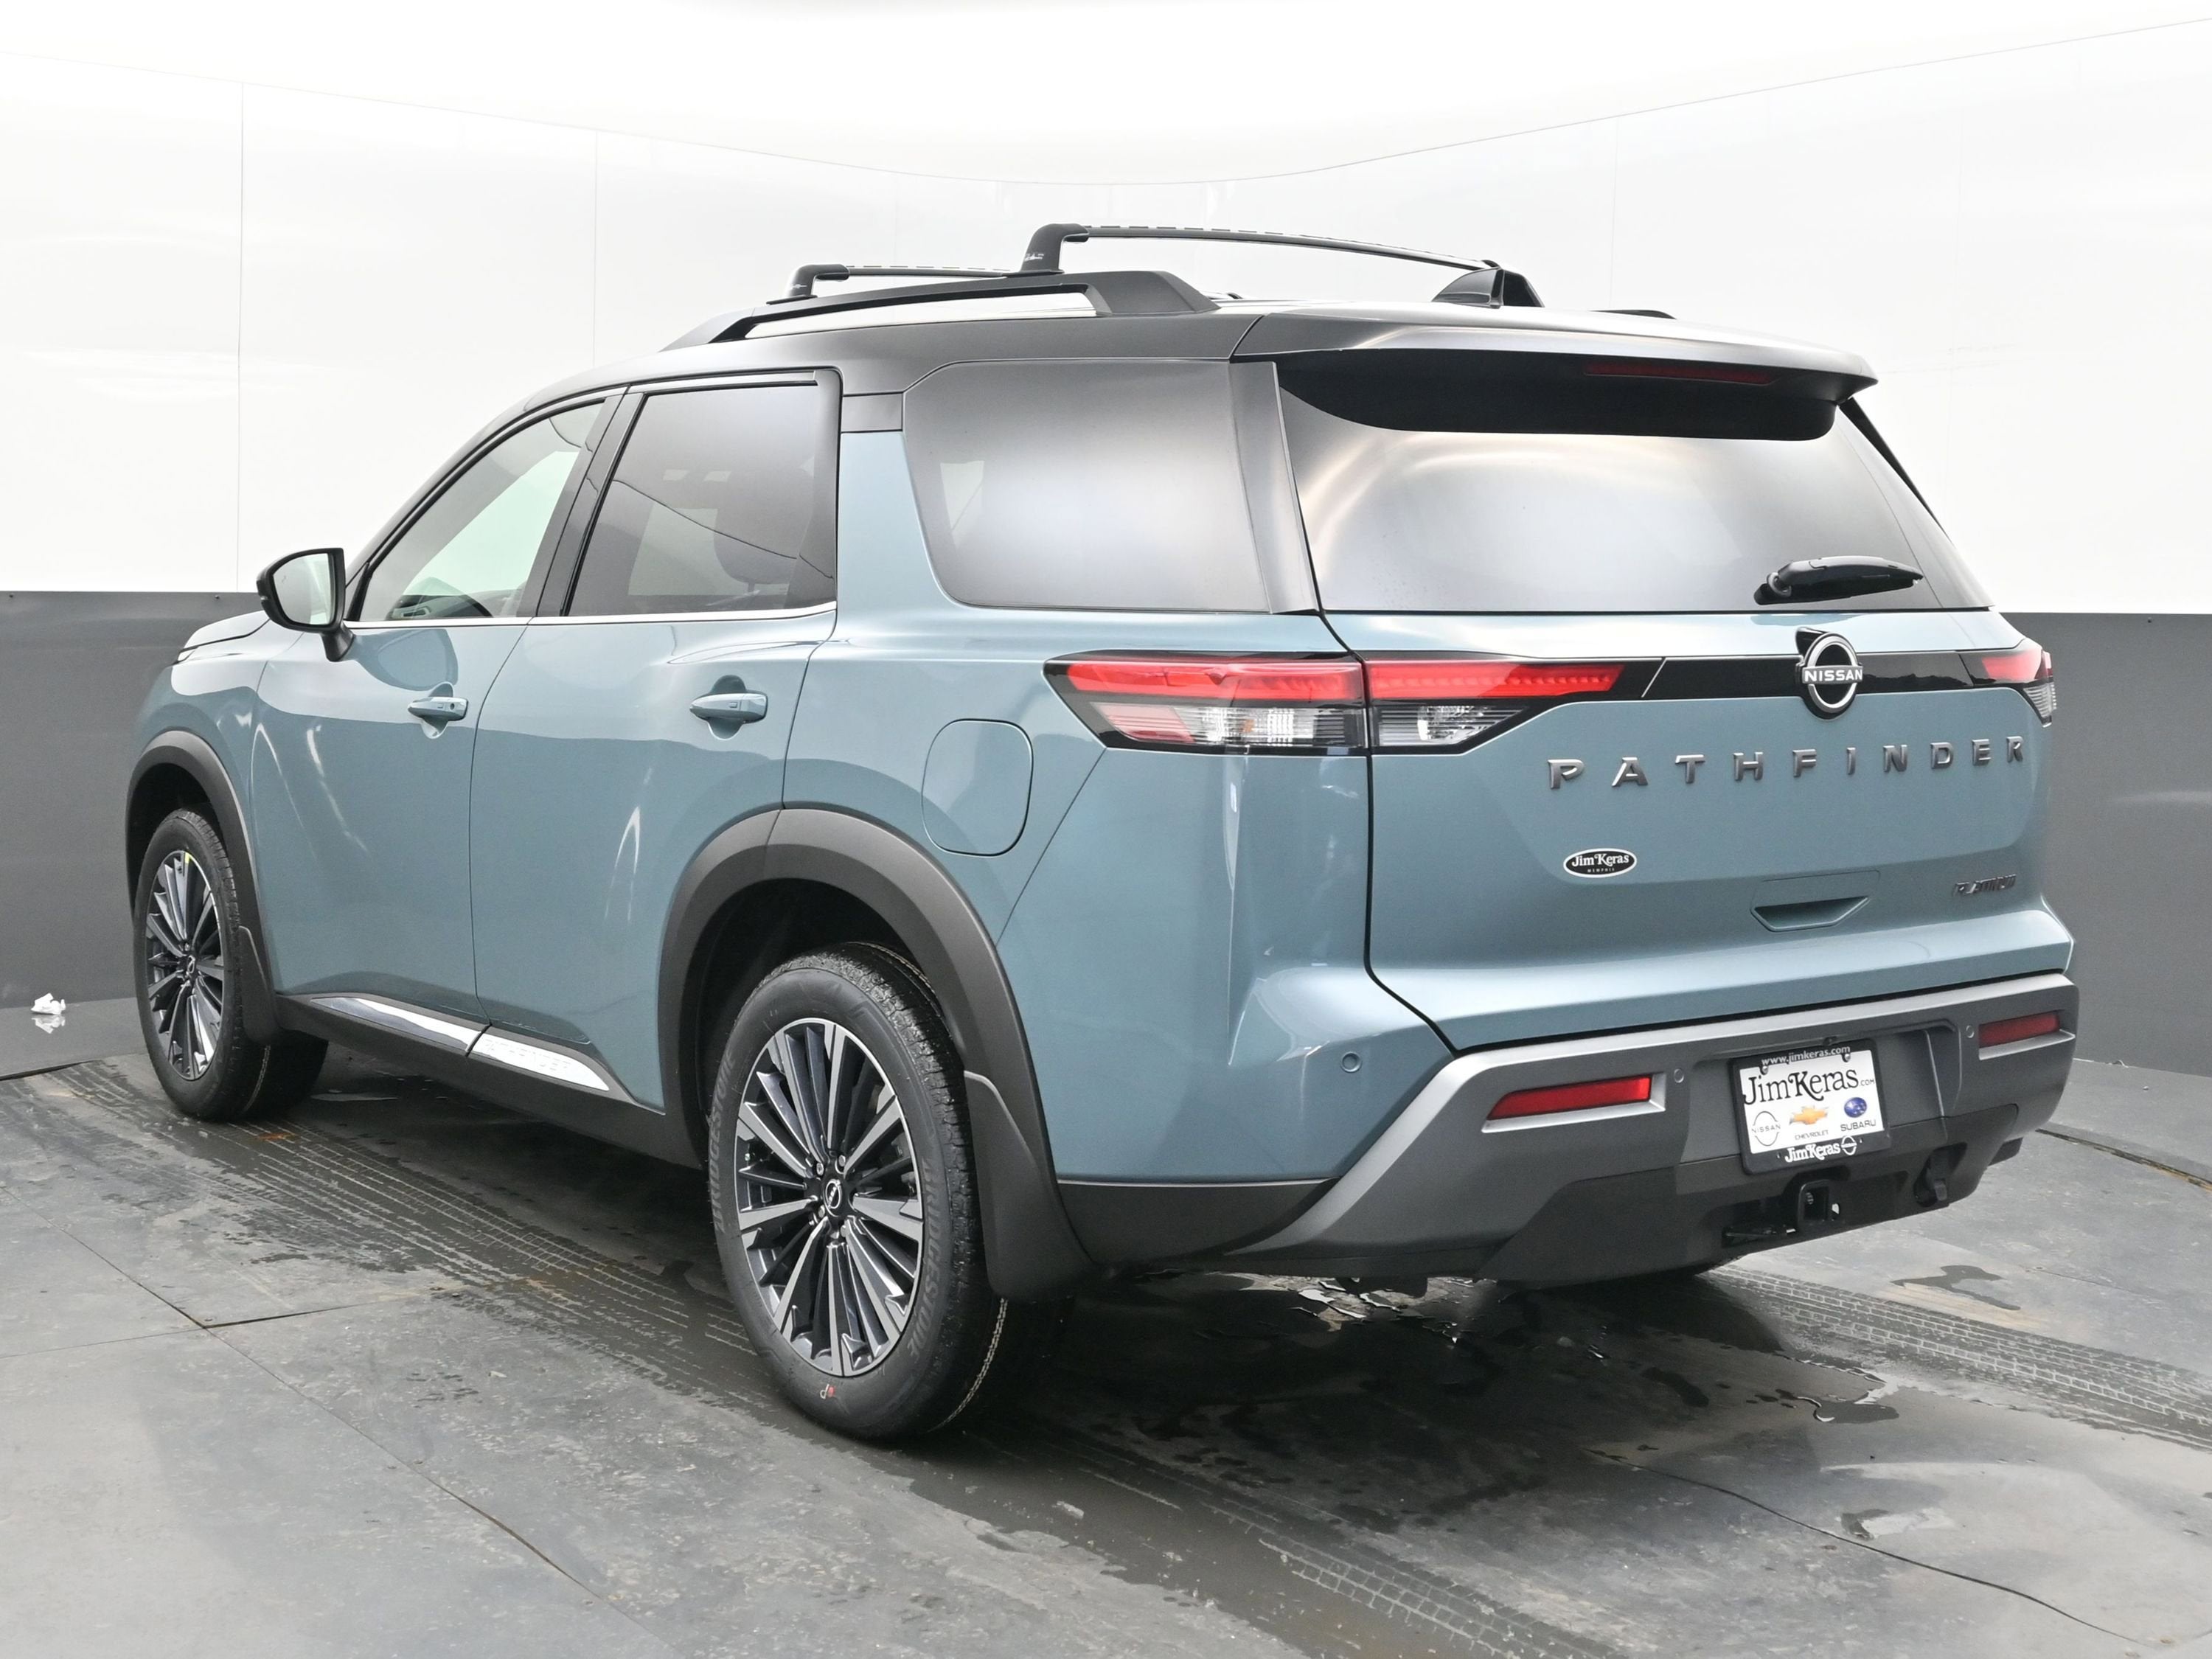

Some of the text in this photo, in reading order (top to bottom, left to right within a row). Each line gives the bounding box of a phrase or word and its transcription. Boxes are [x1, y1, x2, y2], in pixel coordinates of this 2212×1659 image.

[1804, 669, 1863, 682] NISSAN
[1548, 735, 2025, 790] PATHFINDER
[1761, 1045, 1851, 1066] www.jimkeras.com
[1751, 1124, 1781, 1134] NISSAN
[1840, 1119, 1877, 1132] SUBARU
[1795, 1129, 1829, 1141] CHEVROLET
